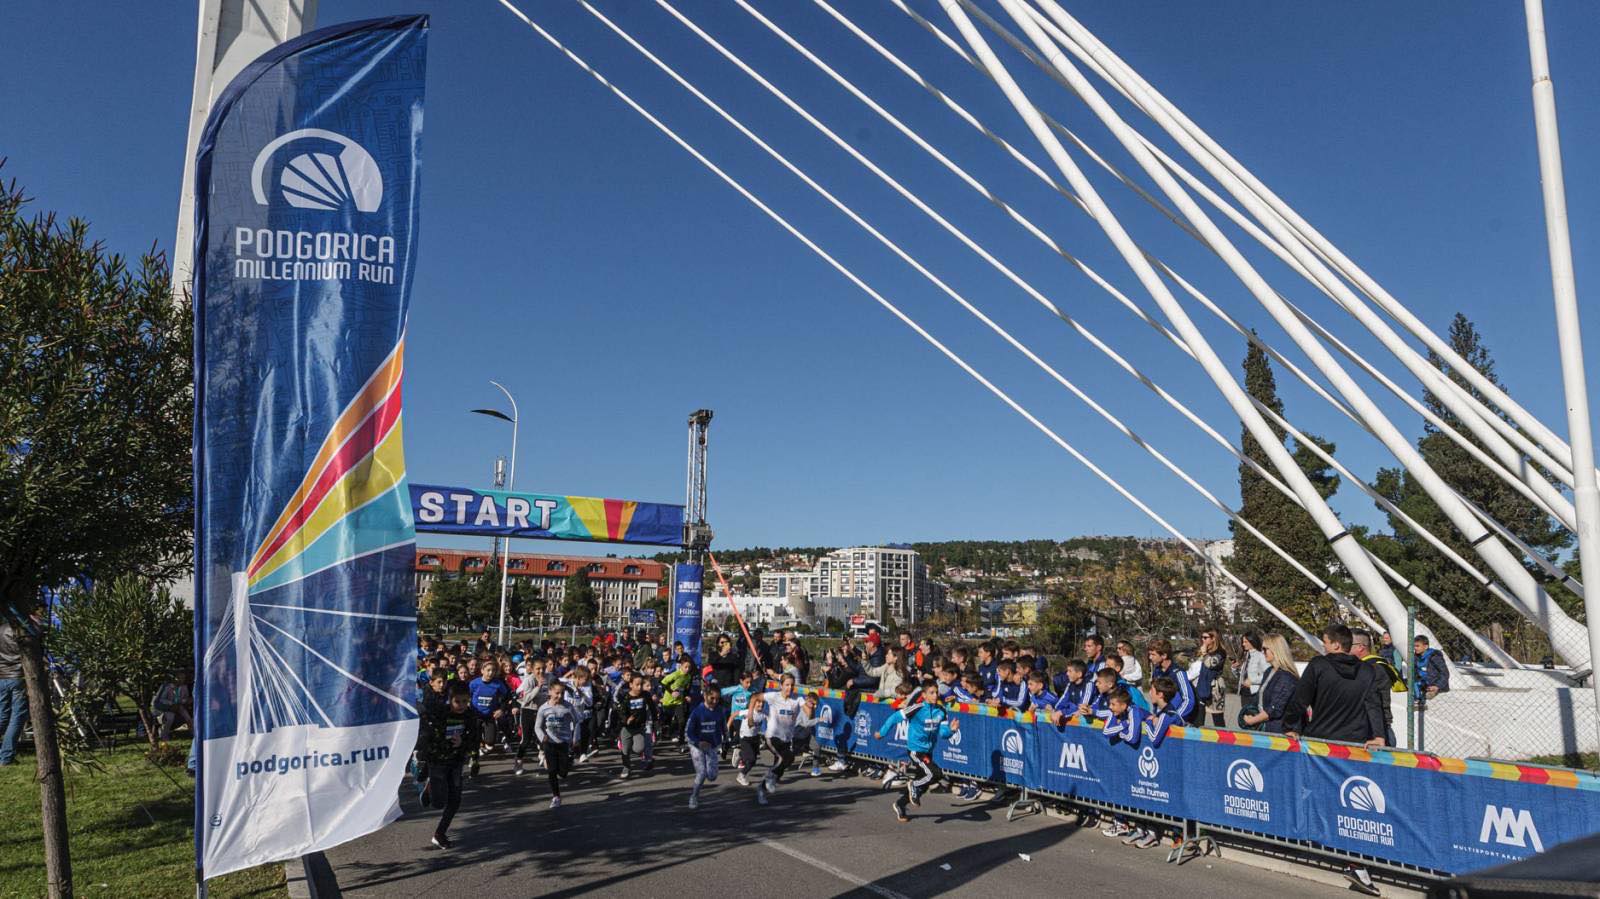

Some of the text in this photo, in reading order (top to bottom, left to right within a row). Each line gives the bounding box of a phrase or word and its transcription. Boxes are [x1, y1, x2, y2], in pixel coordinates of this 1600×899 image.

[235, 227, 395, 264] PODGORICA
[235, 259, 394, 284] MILLENNIUM RUN
[418, 491, 558, 530] START
[236, 745, 390, 779] podgorica.run
[1223, 794, 1270, 813] PODGORICA
[1337, 814, 1394, 837] PODGORICA
[1452, 844, 1499, 857] MULTISPORT
